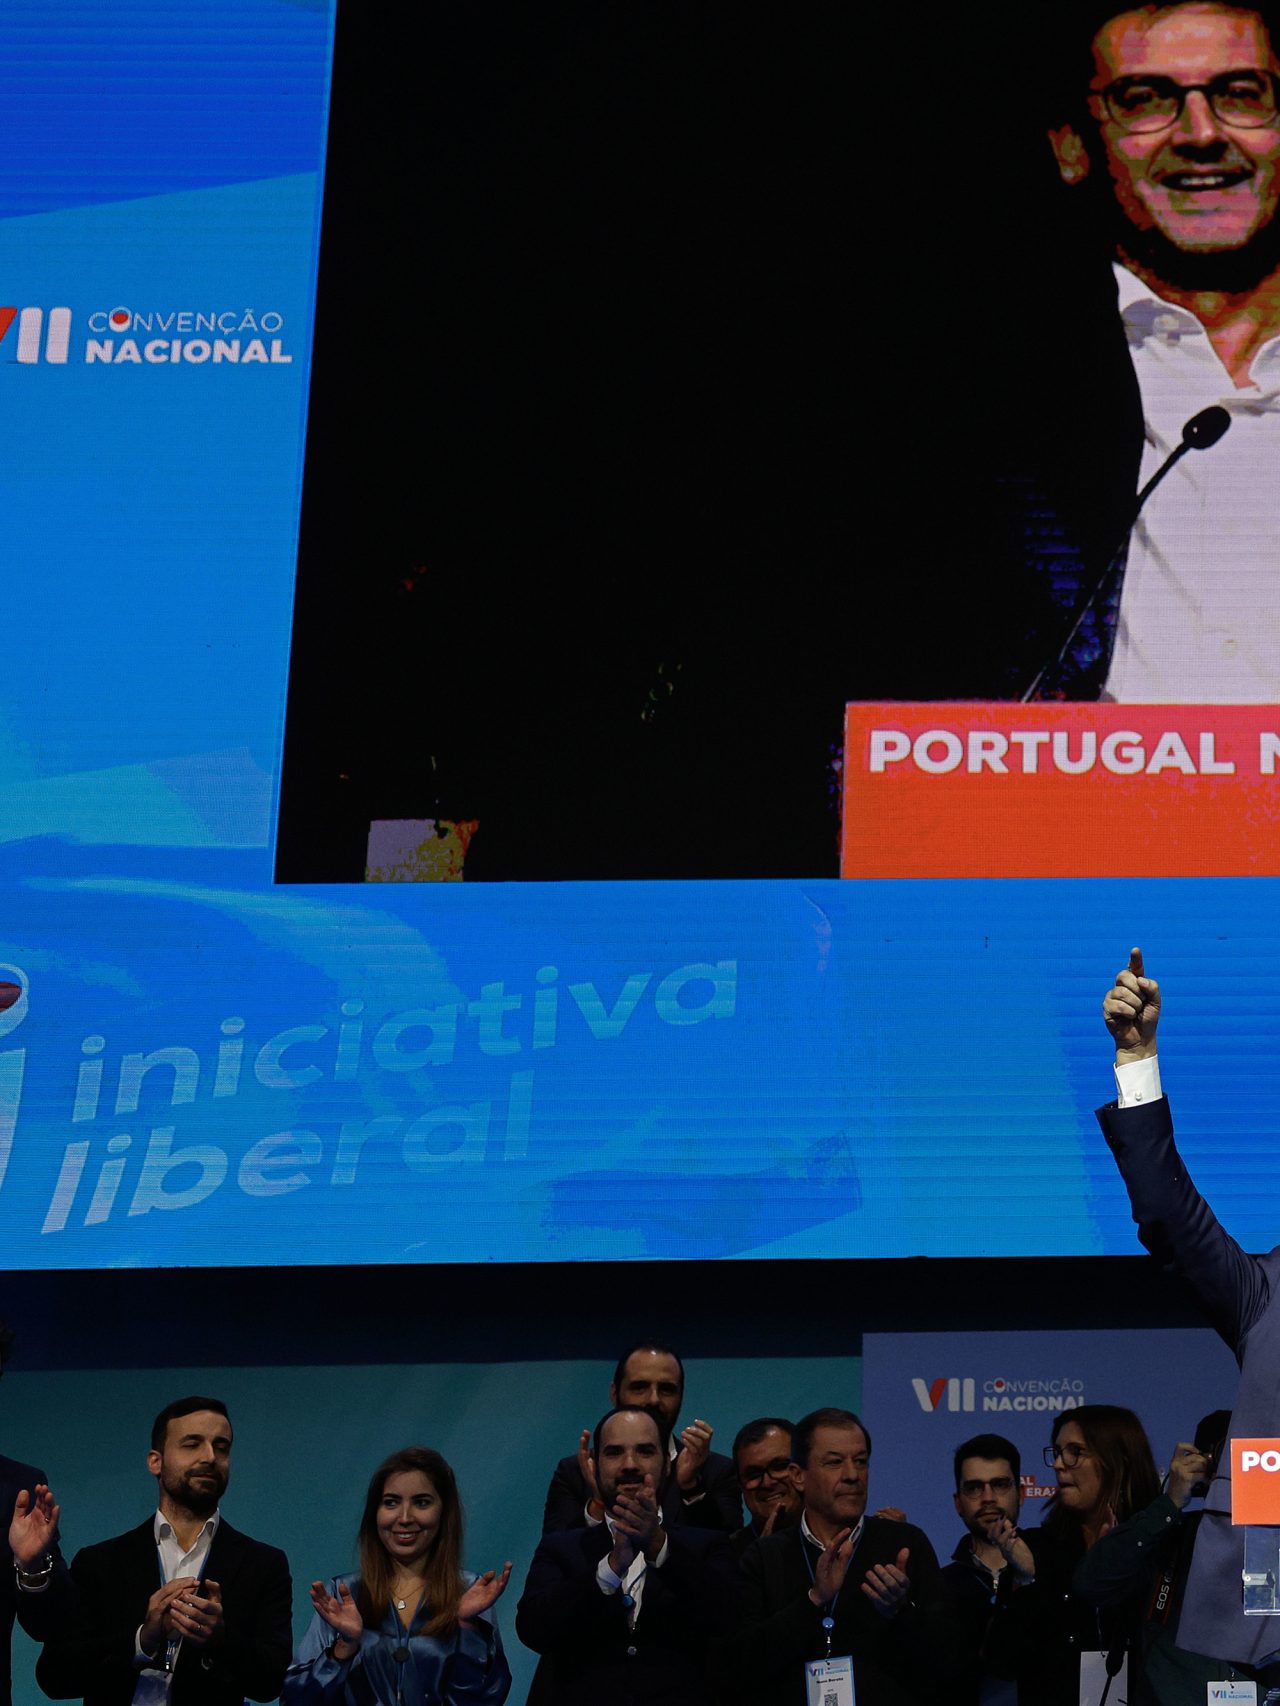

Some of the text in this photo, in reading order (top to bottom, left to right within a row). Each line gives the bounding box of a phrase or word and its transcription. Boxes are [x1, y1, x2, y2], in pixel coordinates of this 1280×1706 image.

[88, 306, 284, 335] CONVENÇÃO
[85, 339, 293, 364] NACIONAL
[868, 730, 1235, 775] PORTUGAL
[72, 959, 740, 1123] iniciativa
[41, 1069, 535, 1235] liberal
[911, 1377, 976, 1412] VII
[983, 1377, 1084, 1393] CONVENÇÃO
[1156, 1584, 1170, 1610] EOS
